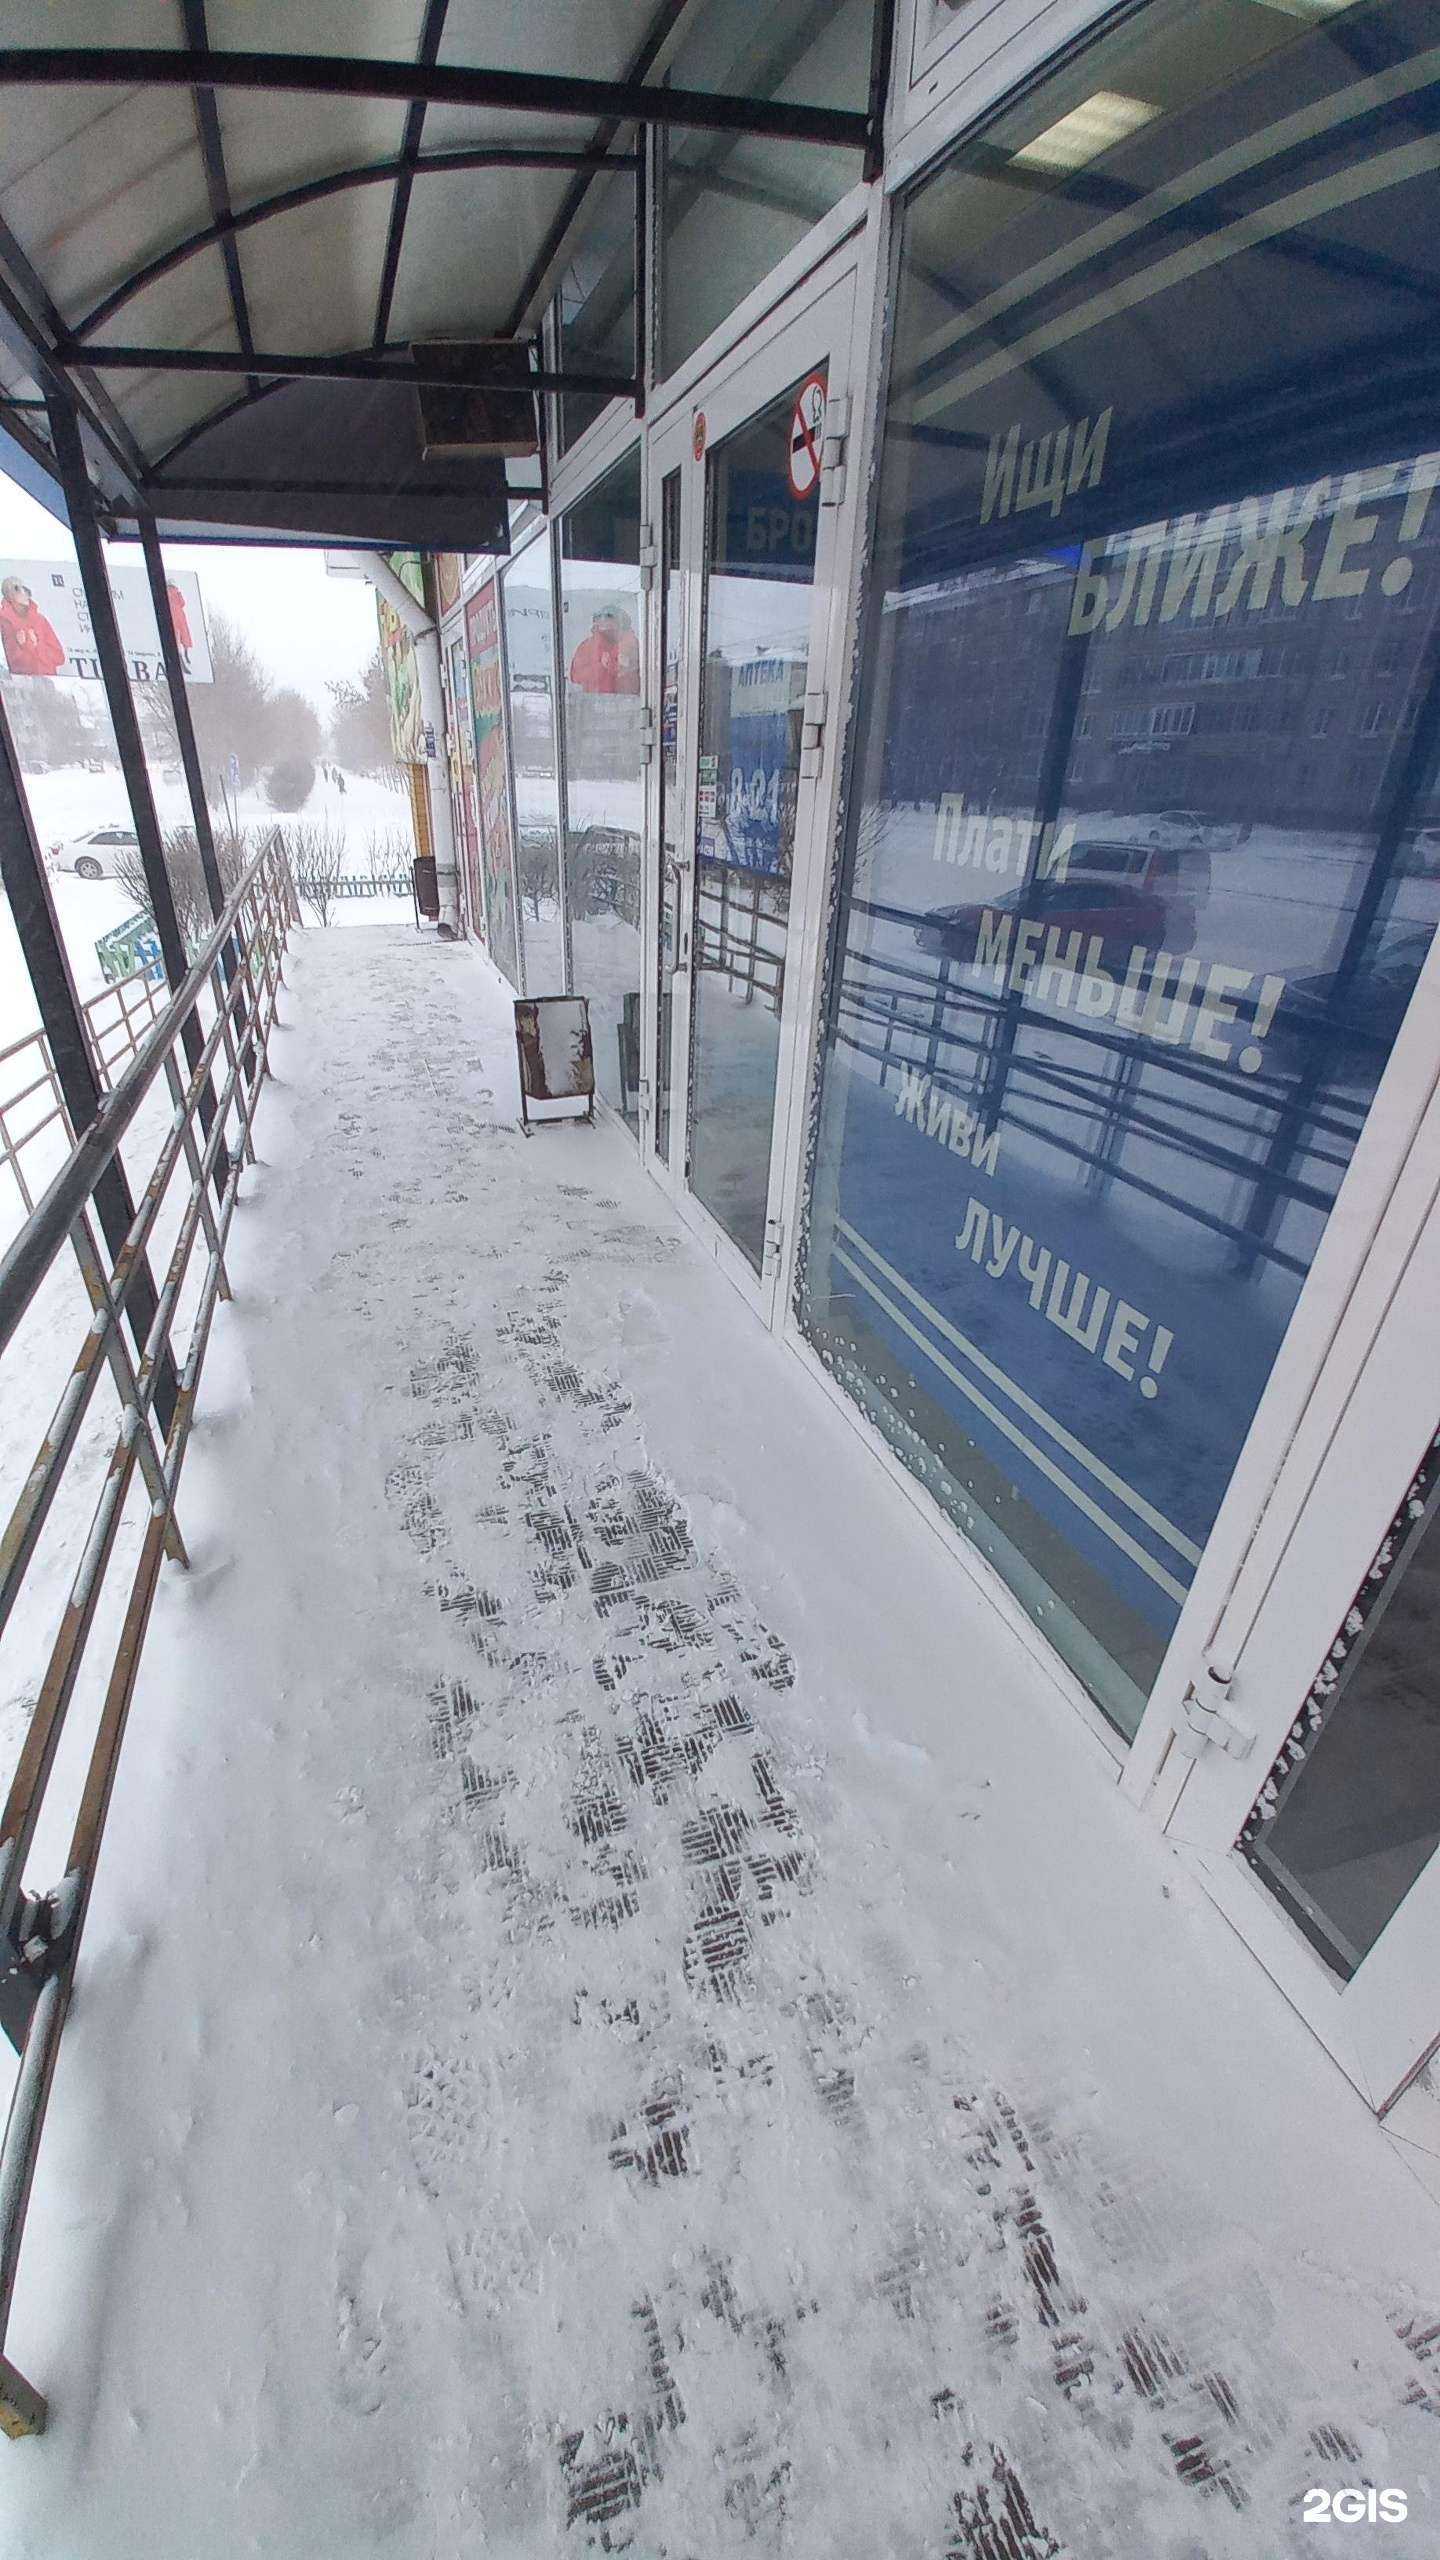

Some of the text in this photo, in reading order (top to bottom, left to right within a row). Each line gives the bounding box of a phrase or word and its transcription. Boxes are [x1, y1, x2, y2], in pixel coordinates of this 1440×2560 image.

[1067, 450, 1440, 638] БЛИЖЕ!
[931, 792, 1078, 884] Плати
[971, 909, 1287, 1075] МЕНЬШЕ!
[894, 1060, 1000, 1178] Живи
[954, 1196, 1175, 1400] ЛУЧШЕ!
